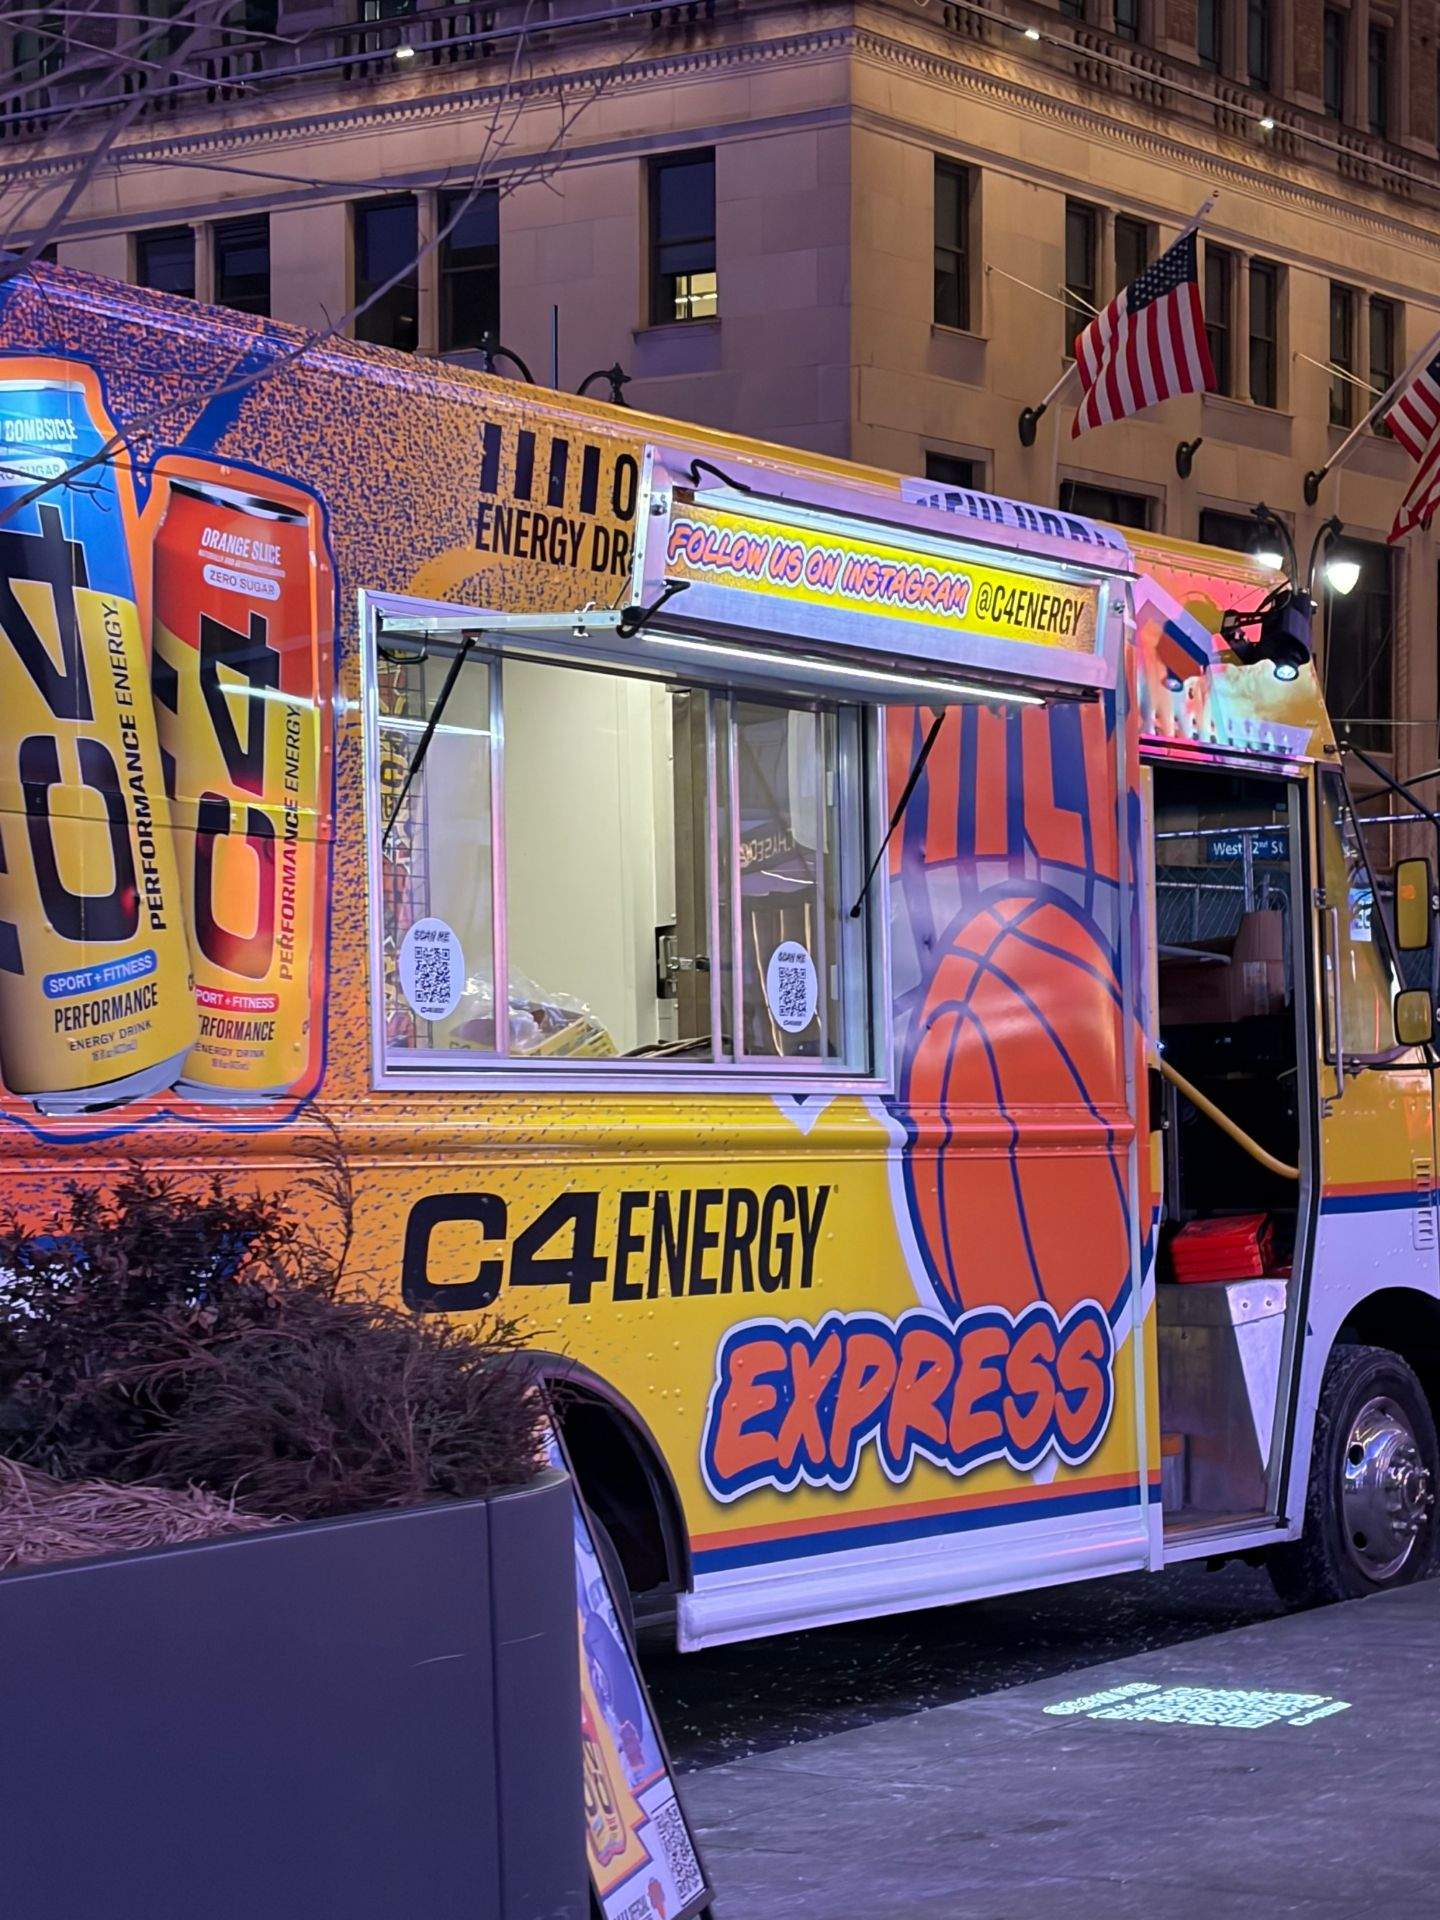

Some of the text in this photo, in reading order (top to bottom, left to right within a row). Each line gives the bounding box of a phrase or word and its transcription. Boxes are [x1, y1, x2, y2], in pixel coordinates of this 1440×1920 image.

[201, 527, 250, 558] ORANGE
[251, 541, 282, 566] SLICE
[475, 501, 636, 578] ENERGY DR
[209, 569, 275, 594] ZERO SUGAR
[666, 522, 1085, 637] FOLLOW US ON INSTAGRAM @C4ENERGY
[102, 602, 167, 930] PERFORMANCE ENERGY
[279, 704, 302, 981] PERFORMANCE ENERGY
[1213, 842, 1243, 856] West
[1271, 841, 1284, 854] St
[50, 972, 93, 993] SPORT
[103, 955, 153, 983] FITNESS
[54, 982, 160, 1034] PERFORMANCE
[195, 989, 224, 1006] PORT
[232, 995, 275, 1009] FITNESS
[69, 1032, 115, 1051] ENERGY
[119, 1020, 152, 1040] DRINK
[199, 1014, 276, 1041] RFORMANCE
[708, 1310, 1109, 1488] EXPRESS
